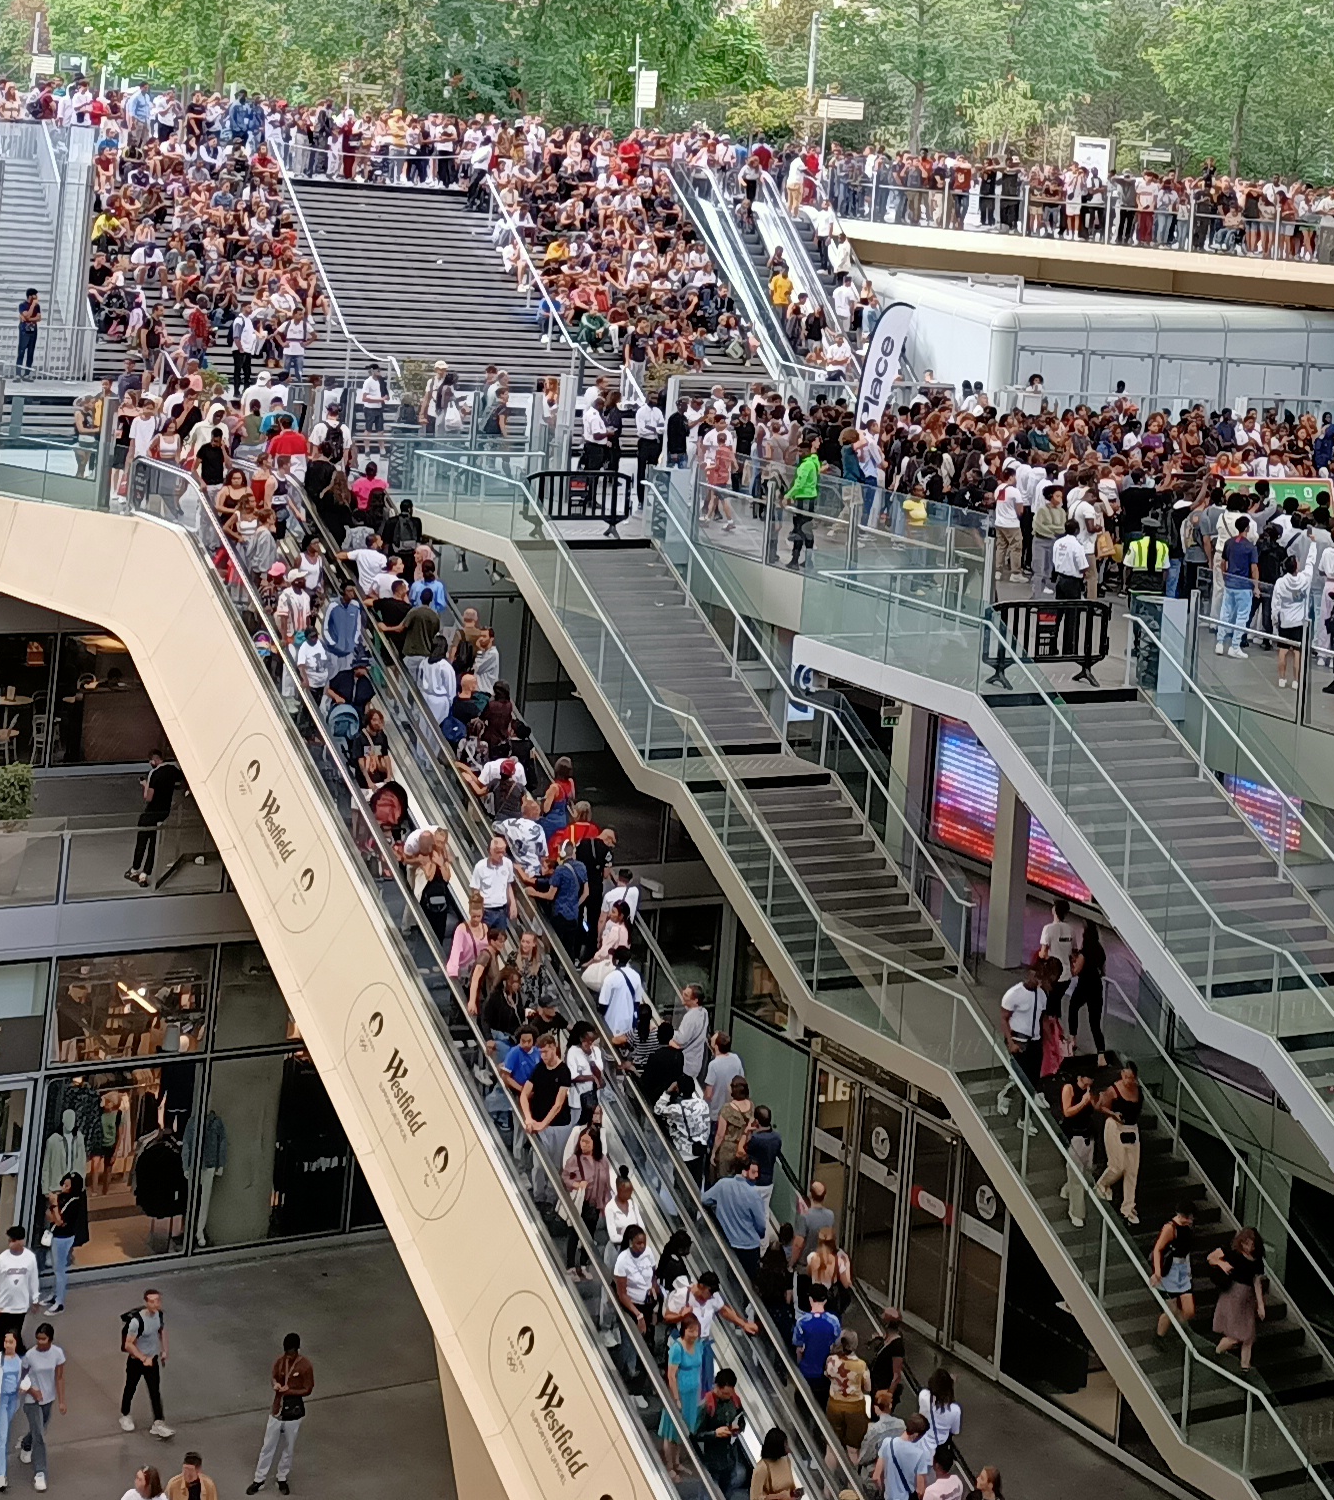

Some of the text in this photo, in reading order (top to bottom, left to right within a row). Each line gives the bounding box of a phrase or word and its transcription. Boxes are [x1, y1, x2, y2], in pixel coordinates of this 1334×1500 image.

[258, 788, 297, 864] Westfield
[382, 1046, 428, 1138] Westfield
[534, 1370, 590, 1480] Westfield
